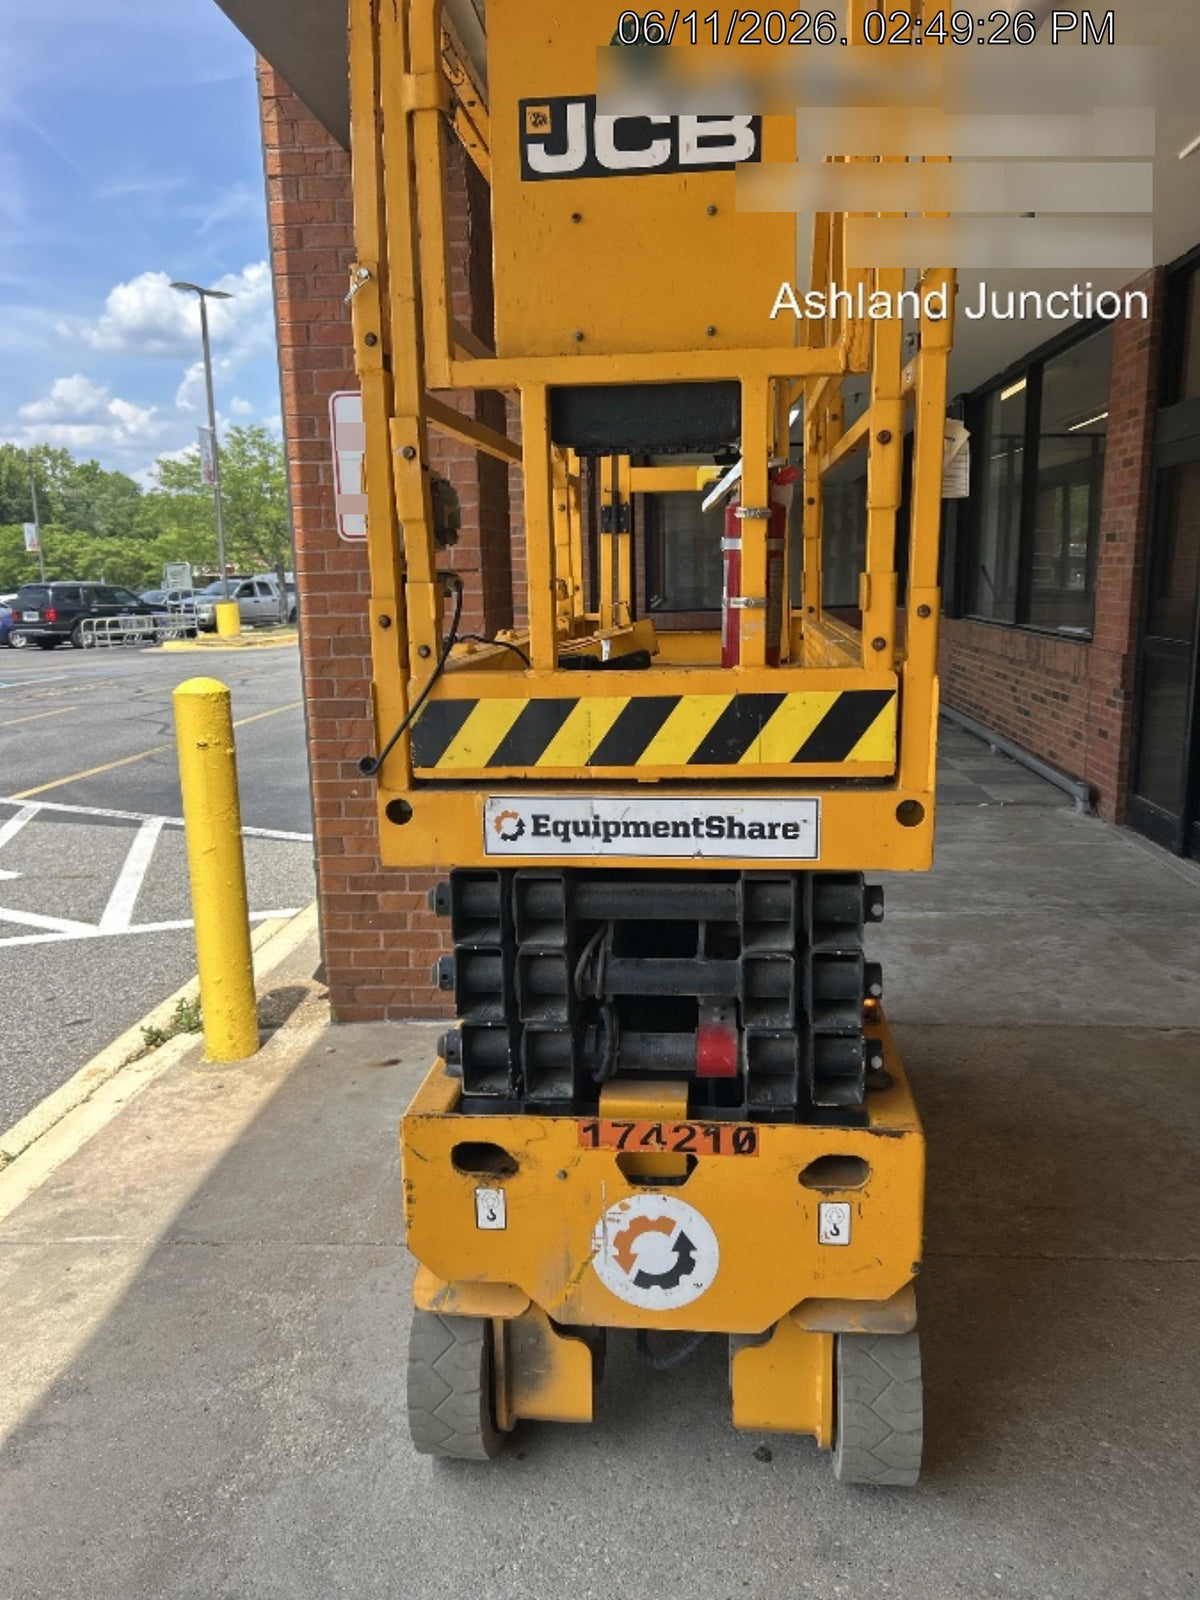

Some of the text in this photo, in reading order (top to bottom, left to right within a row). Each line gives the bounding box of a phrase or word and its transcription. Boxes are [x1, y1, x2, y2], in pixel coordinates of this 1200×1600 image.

[527, 102, 756, 173] JCB
[531, 814, 800, 843] EquipmentShare
[582, 1121, 757, 1154] 174210
